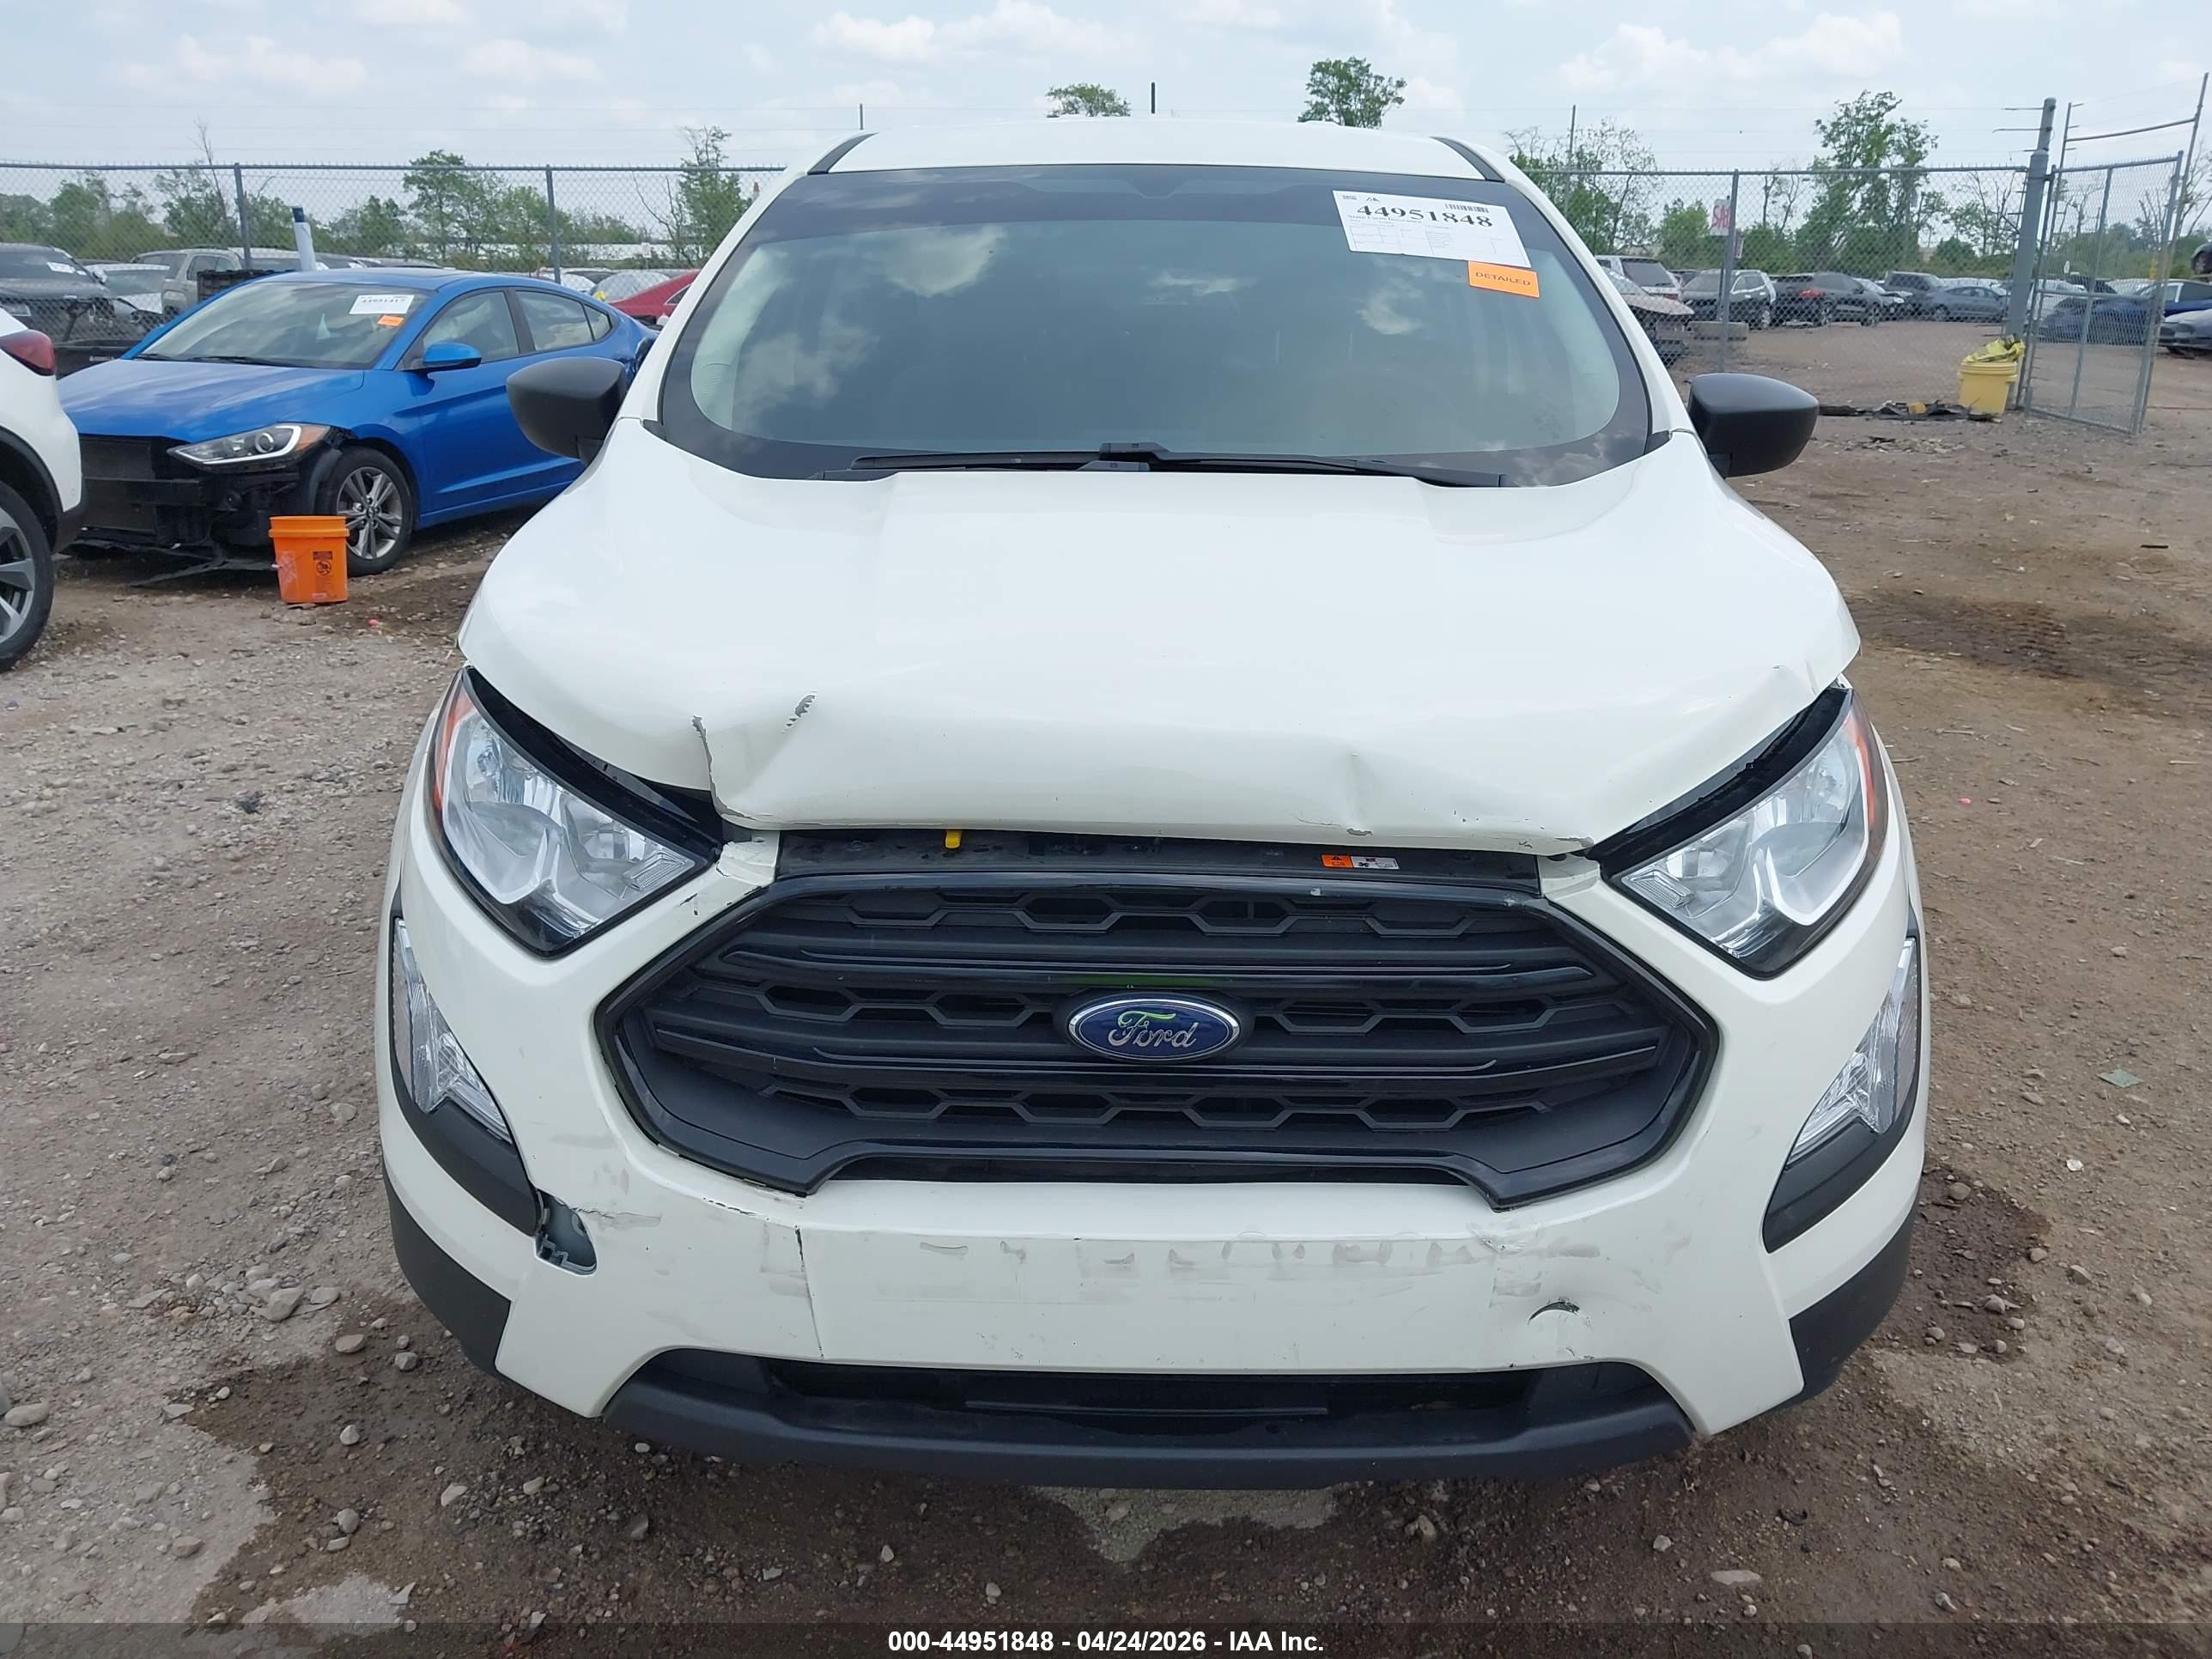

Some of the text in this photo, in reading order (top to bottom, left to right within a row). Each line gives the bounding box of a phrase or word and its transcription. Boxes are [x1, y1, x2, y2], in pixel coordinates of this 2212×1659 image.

[1357, 205, 1493, 228] 44951848
[1475, 271, 1531, 286] DETAILED
[1107, 1010, 1200, 1048] Ford
